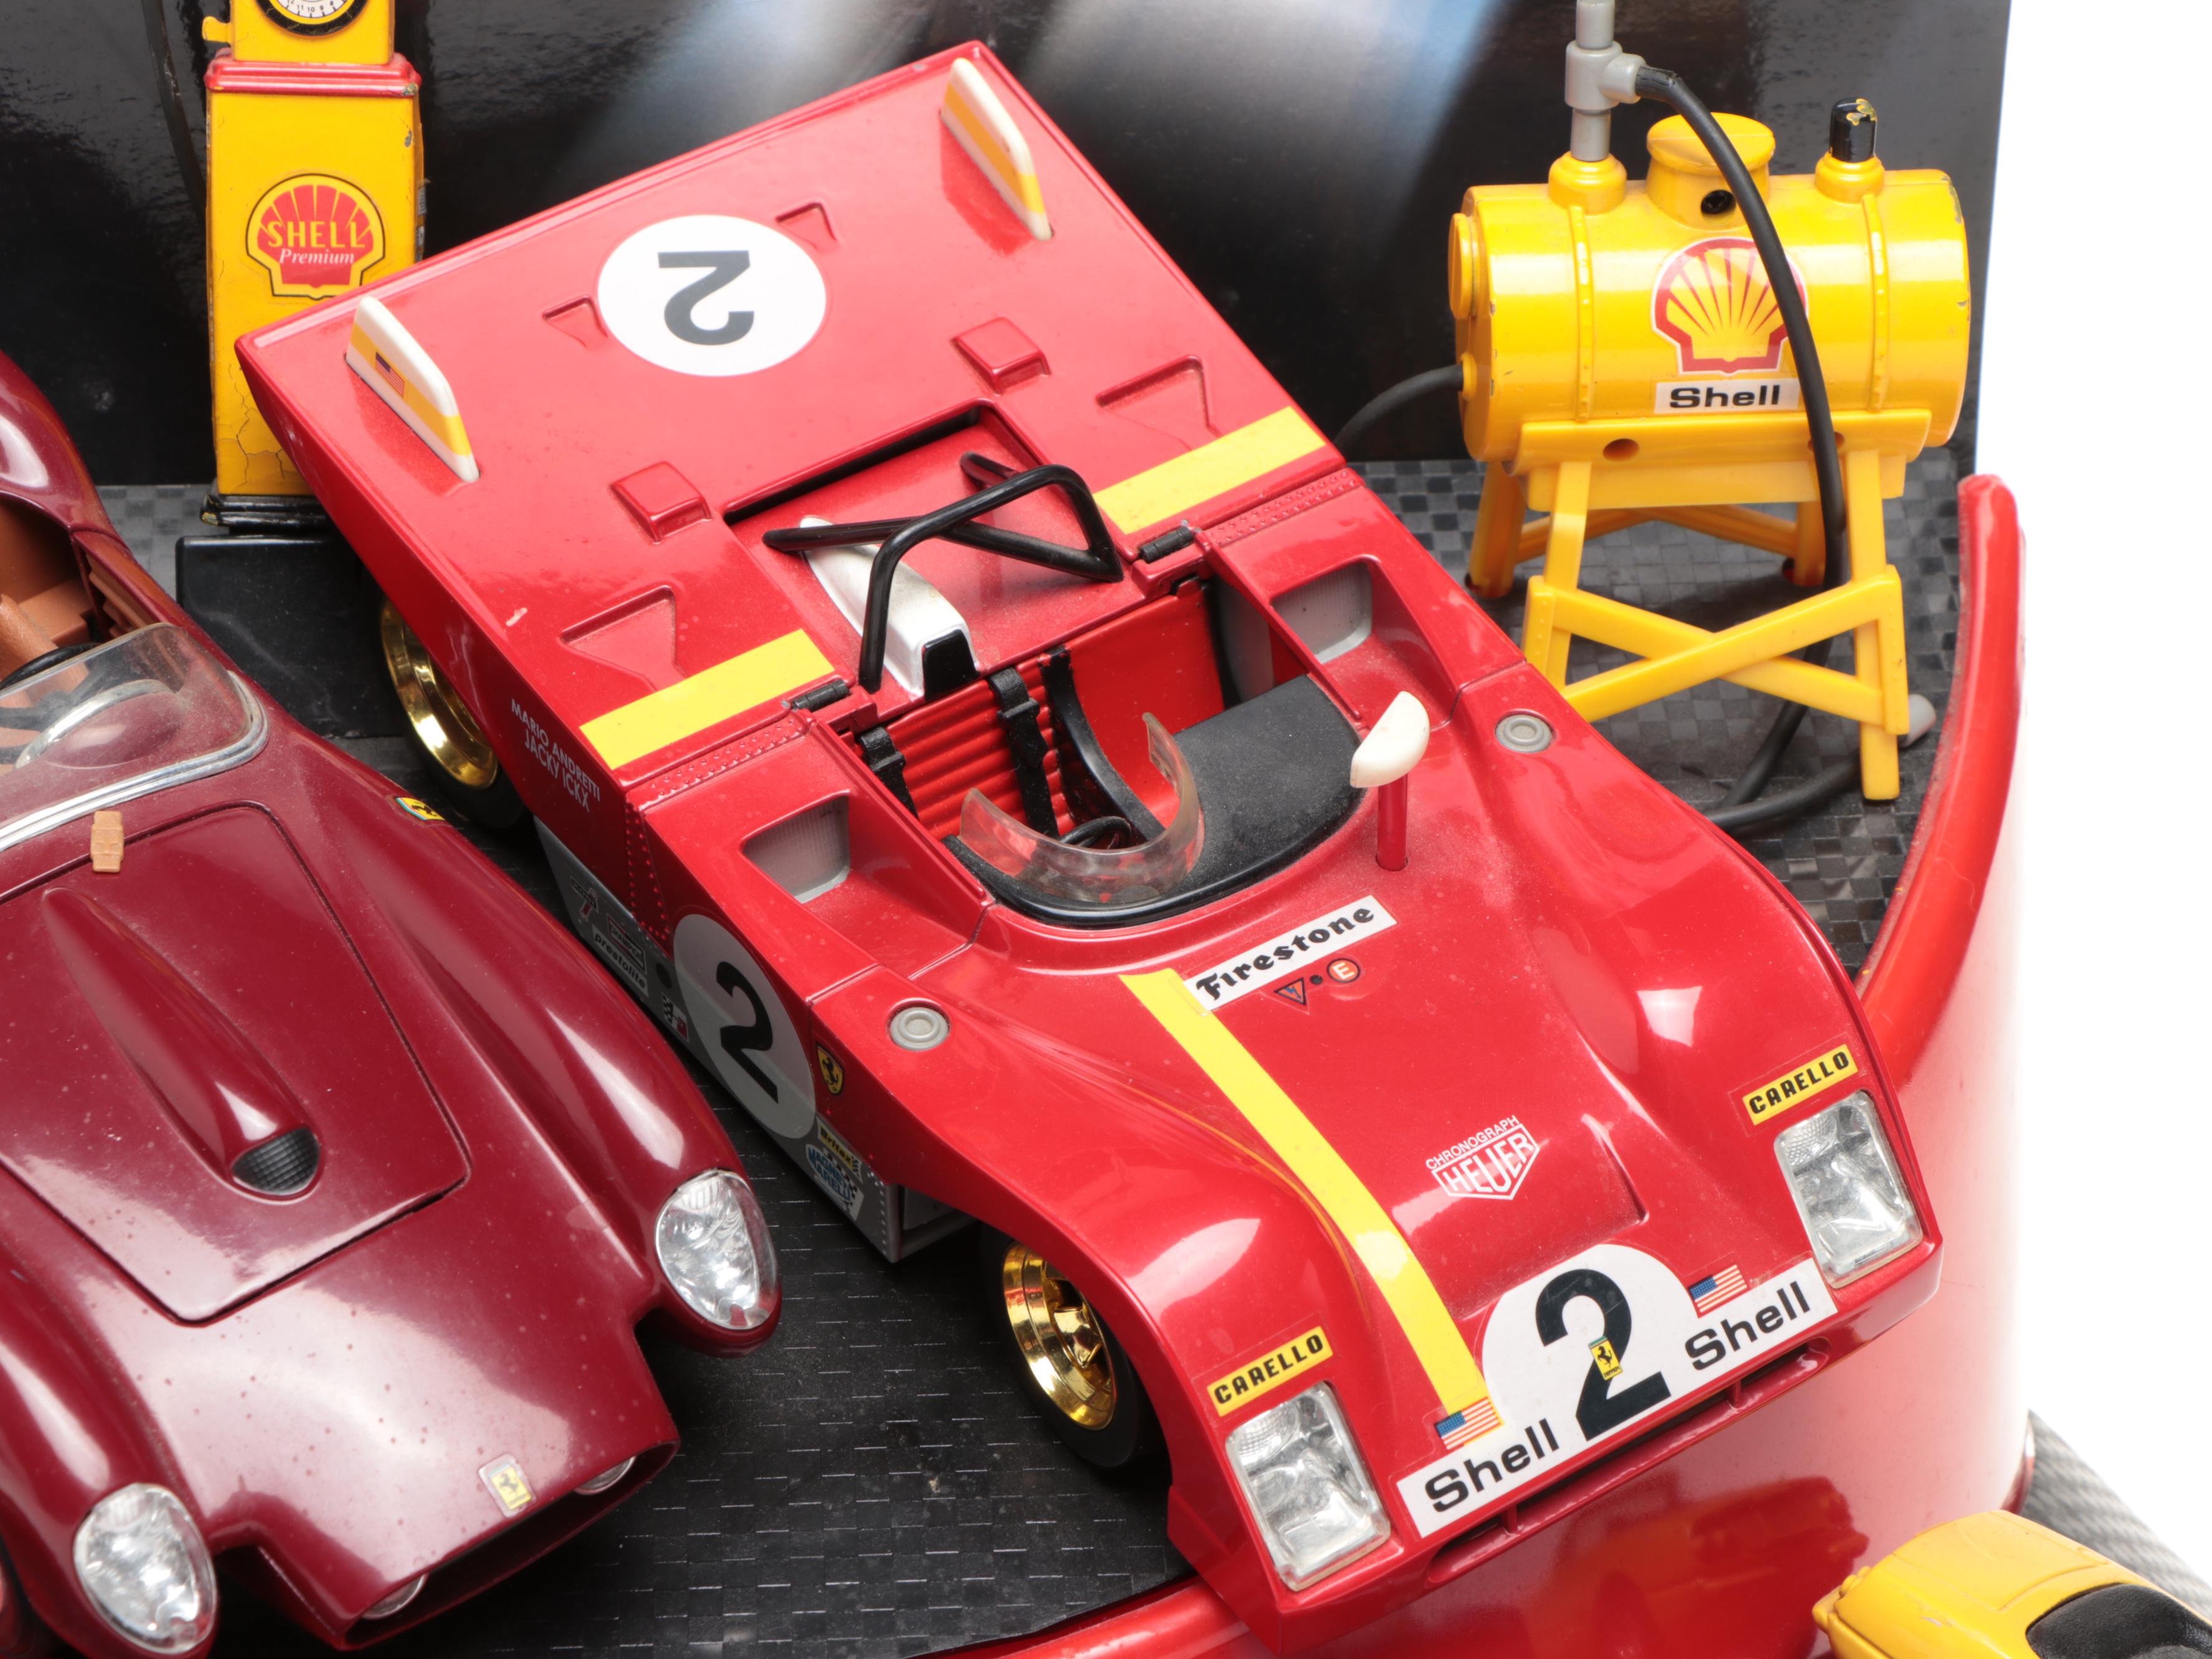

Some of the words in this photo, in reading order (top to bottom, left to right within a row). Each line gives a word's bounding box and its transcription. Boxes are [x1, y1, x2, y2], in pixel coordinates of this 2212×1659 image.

[267, 220, 366, 249] SHELL
[278, 248, 356, 265] Premium
[657, 250, 755, 346] 2
[1669, 384, 1780, 409] Shell
[511, 697, 549, 747] MARIO
[552, 742, 600, 802] ANDRETTI
[524, 729, 559, 779] JACKY
[562, 768, 590, 813] ICKX
[594, 933, 646, 990] prestolite
[1196, 907, 1374, 1001] Firestone
[1331, 962, 1355, 980] E
[716, 961, 779, 1104] 2
[1749, 1051, 1850, 1114] CARELLO
[820, 1125, 852, 1165] Britax
[1425, 1114, 1521, 1170] CHRONOGRAPH
[1442, 1132, 1534, 1193] HEUER
[1534, 1268, 1672, 1442] 2
[1684, 1280, 1811, 1371] Shell
[1214, 1334, 1324, 1404] CARELLO
[1424, 1417, 1559, 1513] Shell
